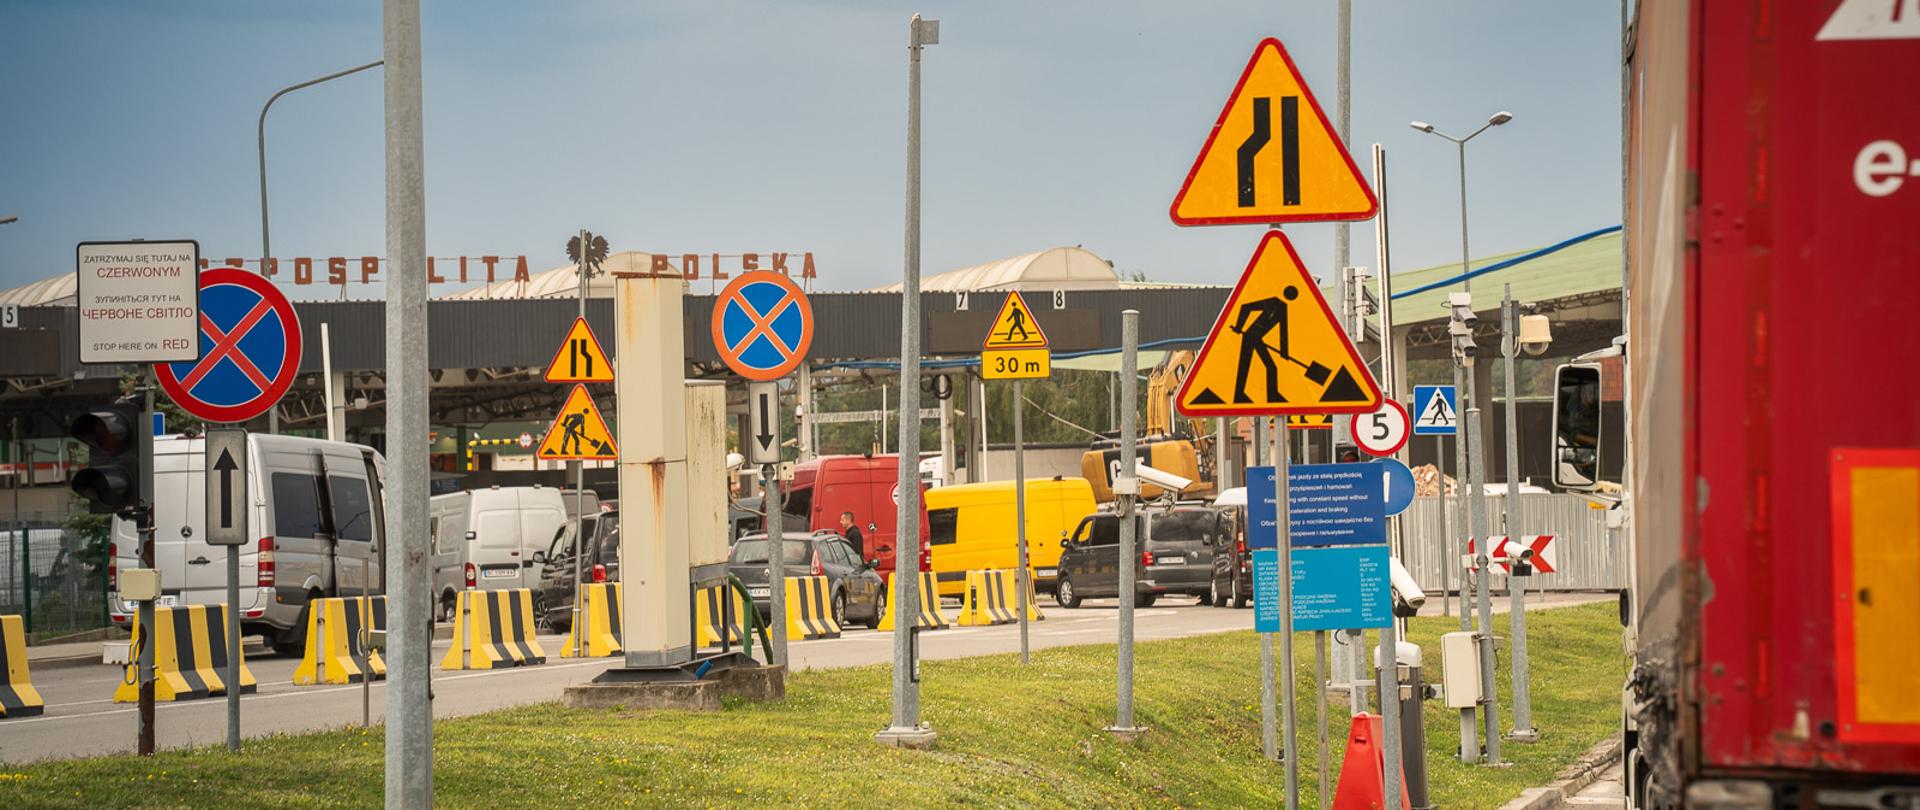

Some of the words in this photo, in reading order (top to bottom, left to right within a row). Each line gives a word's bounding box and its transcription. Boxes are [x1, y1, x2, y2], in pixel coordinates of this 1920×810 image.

[84, 254, 133, 263] ZATRZYMAJ
[135, 255, 149, 264] SIĘ
[152, 254, 177, 262] TUTAJ
[650, 252, 816, 280] POLSKA
[96, 266, 180, 278] CZERWONYM
[95, 295, 149, 303] ЗУПИНІТЬСЯ
[169, 294, 181, 302] НА
[958, 292, 966, 308] 7
[1055, 291, 1063, 307] 8
[6, 306, 13, 324] 5
[82, 308, 143, 319] ЧЕРВОНЕ
[146, 307, 193, 318] СВІТЛО
[93, 342, 117, 351] STOP
[118, 342, 142, 350] HERE
[144, 342, 158, 350] ON
[162, 339, 189, 349] RED
[995, 356, 1019, 373] 30
[1025, 361, 1040, 372] m
[1372, 412, 1389, 440] 5
